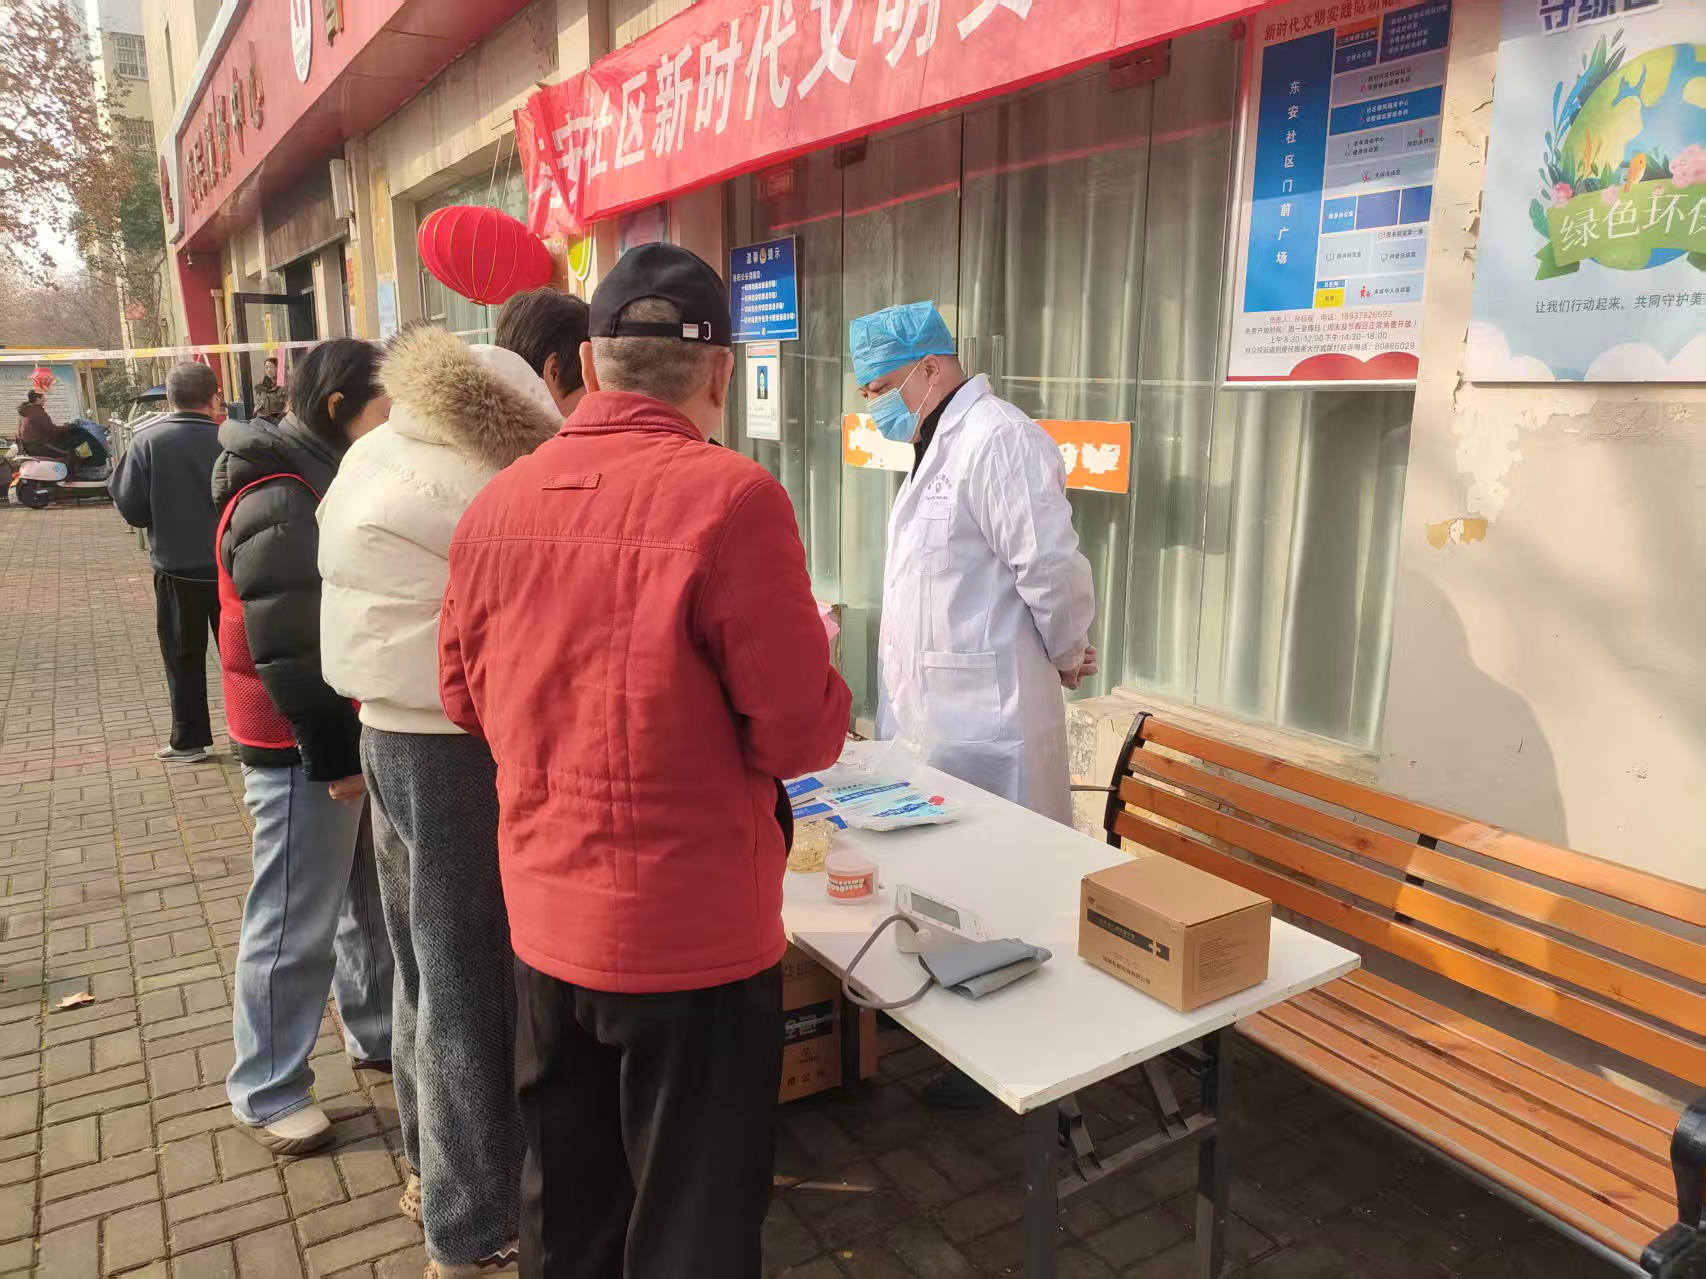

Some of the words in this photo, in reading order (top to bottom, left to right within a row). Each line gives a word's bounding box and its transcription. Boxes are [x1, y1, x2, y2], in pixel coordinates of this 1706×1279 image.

[530, 0, 1033, 210] 安社区新时代文明
[1275, 80, 1301, 264] 东安社区门前广场
